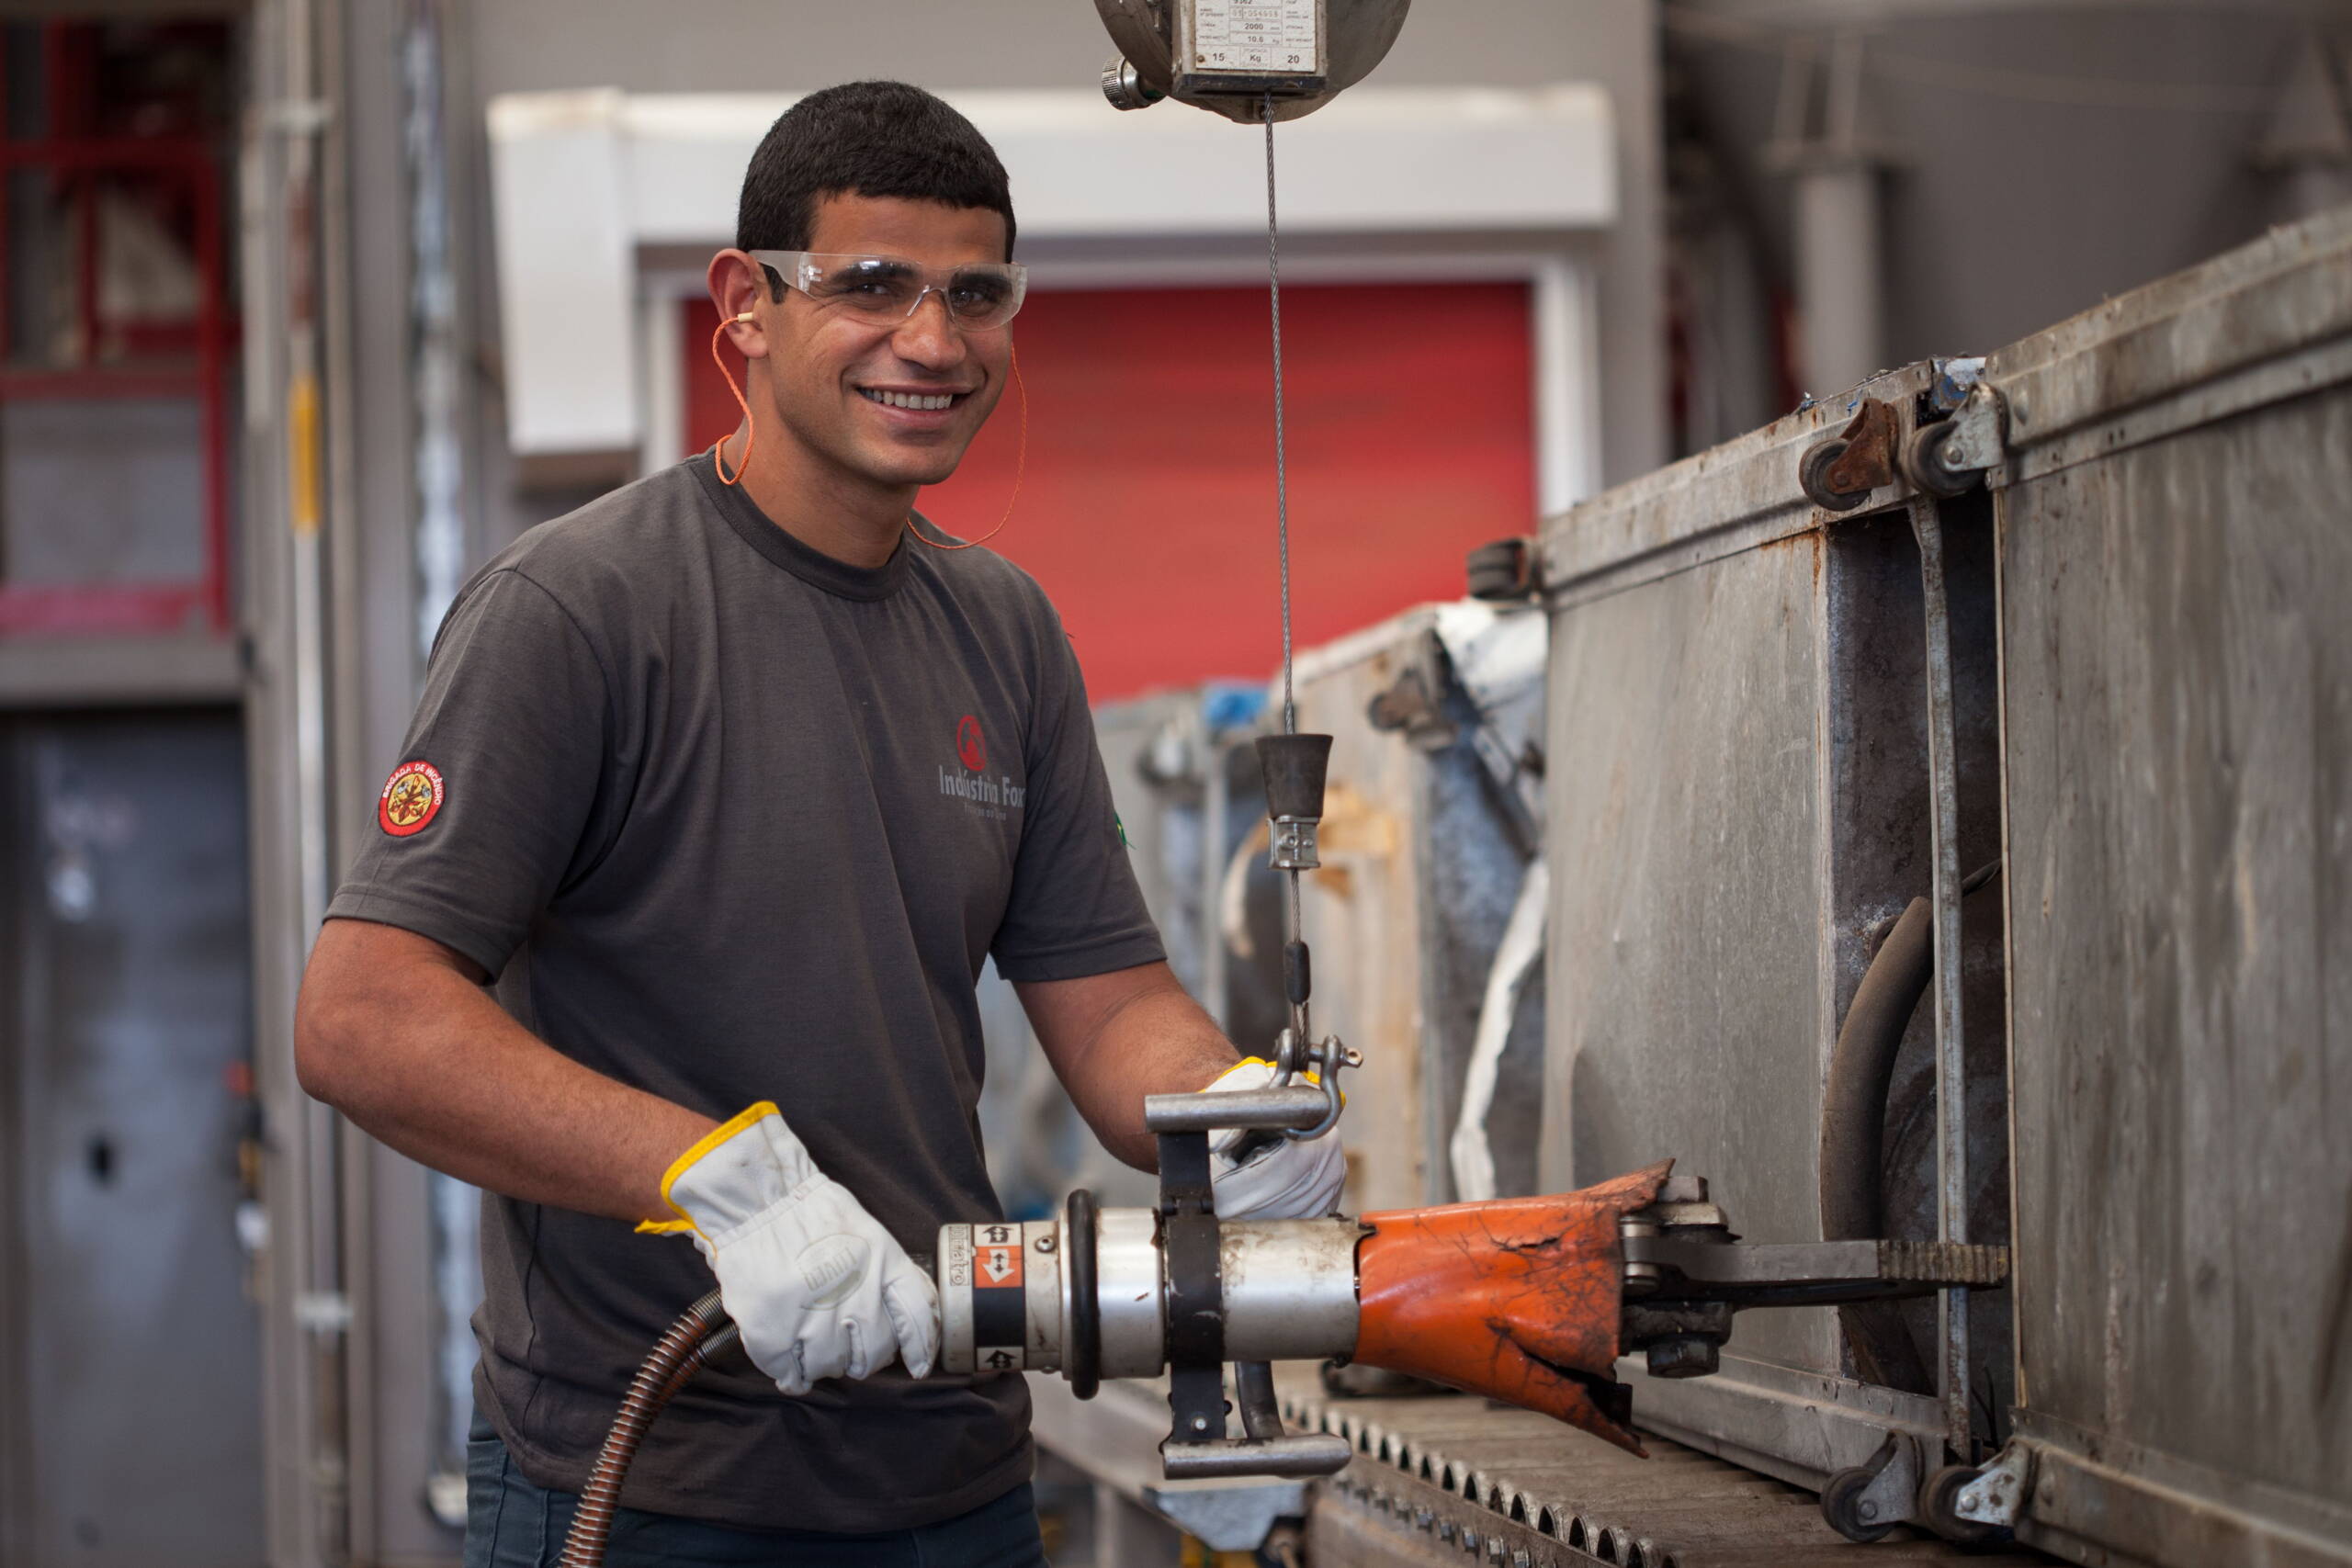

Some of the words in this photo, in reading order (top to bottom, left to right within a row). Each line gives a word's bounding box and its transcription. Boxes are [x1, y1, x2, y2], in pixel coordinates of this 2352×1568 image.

[1212, 53, 1225, 62] 15
[1250, 54, 1261, 62] Kg
[1287, 55, 1300, 63] 20
[382, 766, 412, 797] BRIGADA
[414, 763, 425, 772] DE
[1001, 776, 1026, 808] Fox
